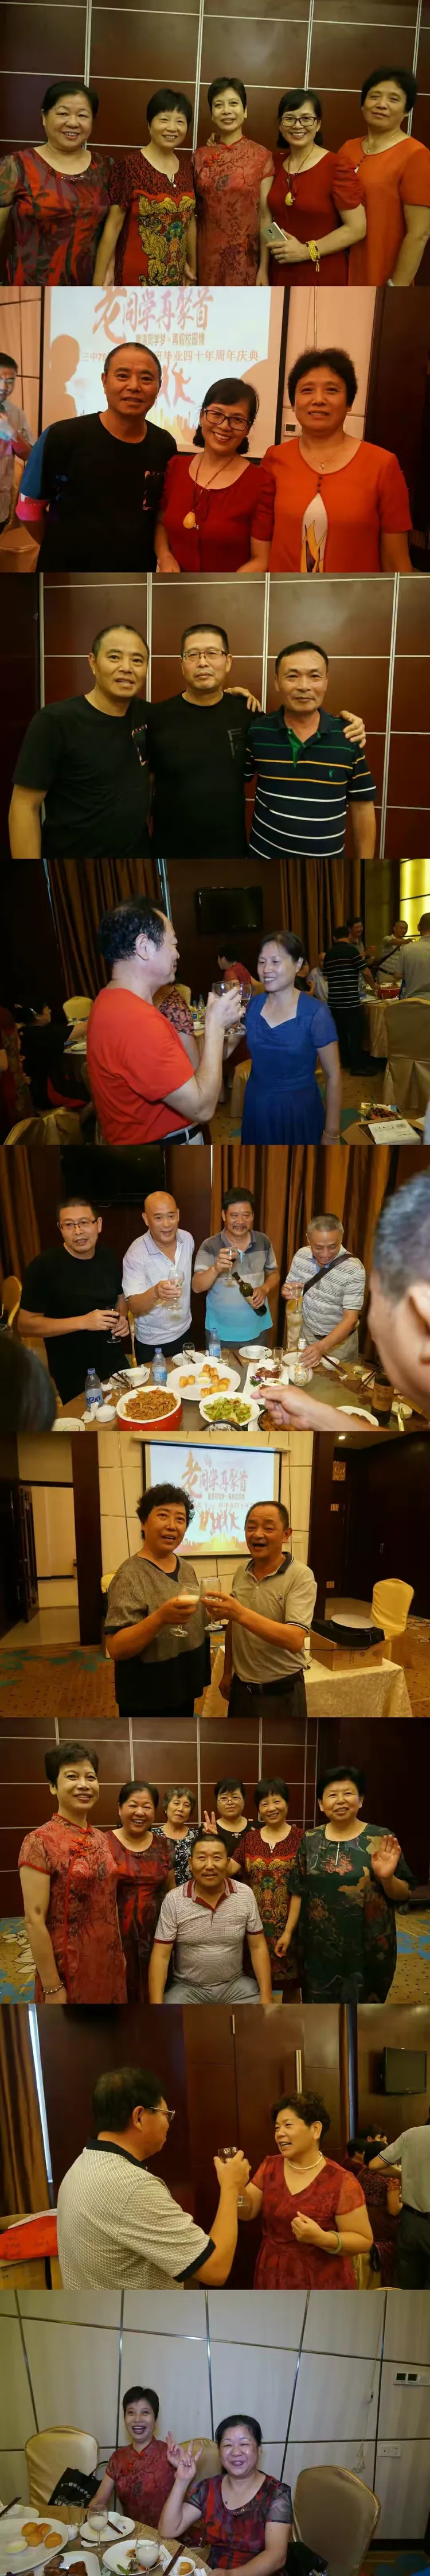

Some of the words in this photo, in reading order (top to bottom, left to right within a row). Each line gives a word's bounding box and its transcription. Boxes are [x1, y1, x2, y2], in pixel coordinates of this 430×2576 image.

[92, 286, 214, 344] 老同学再聚首
